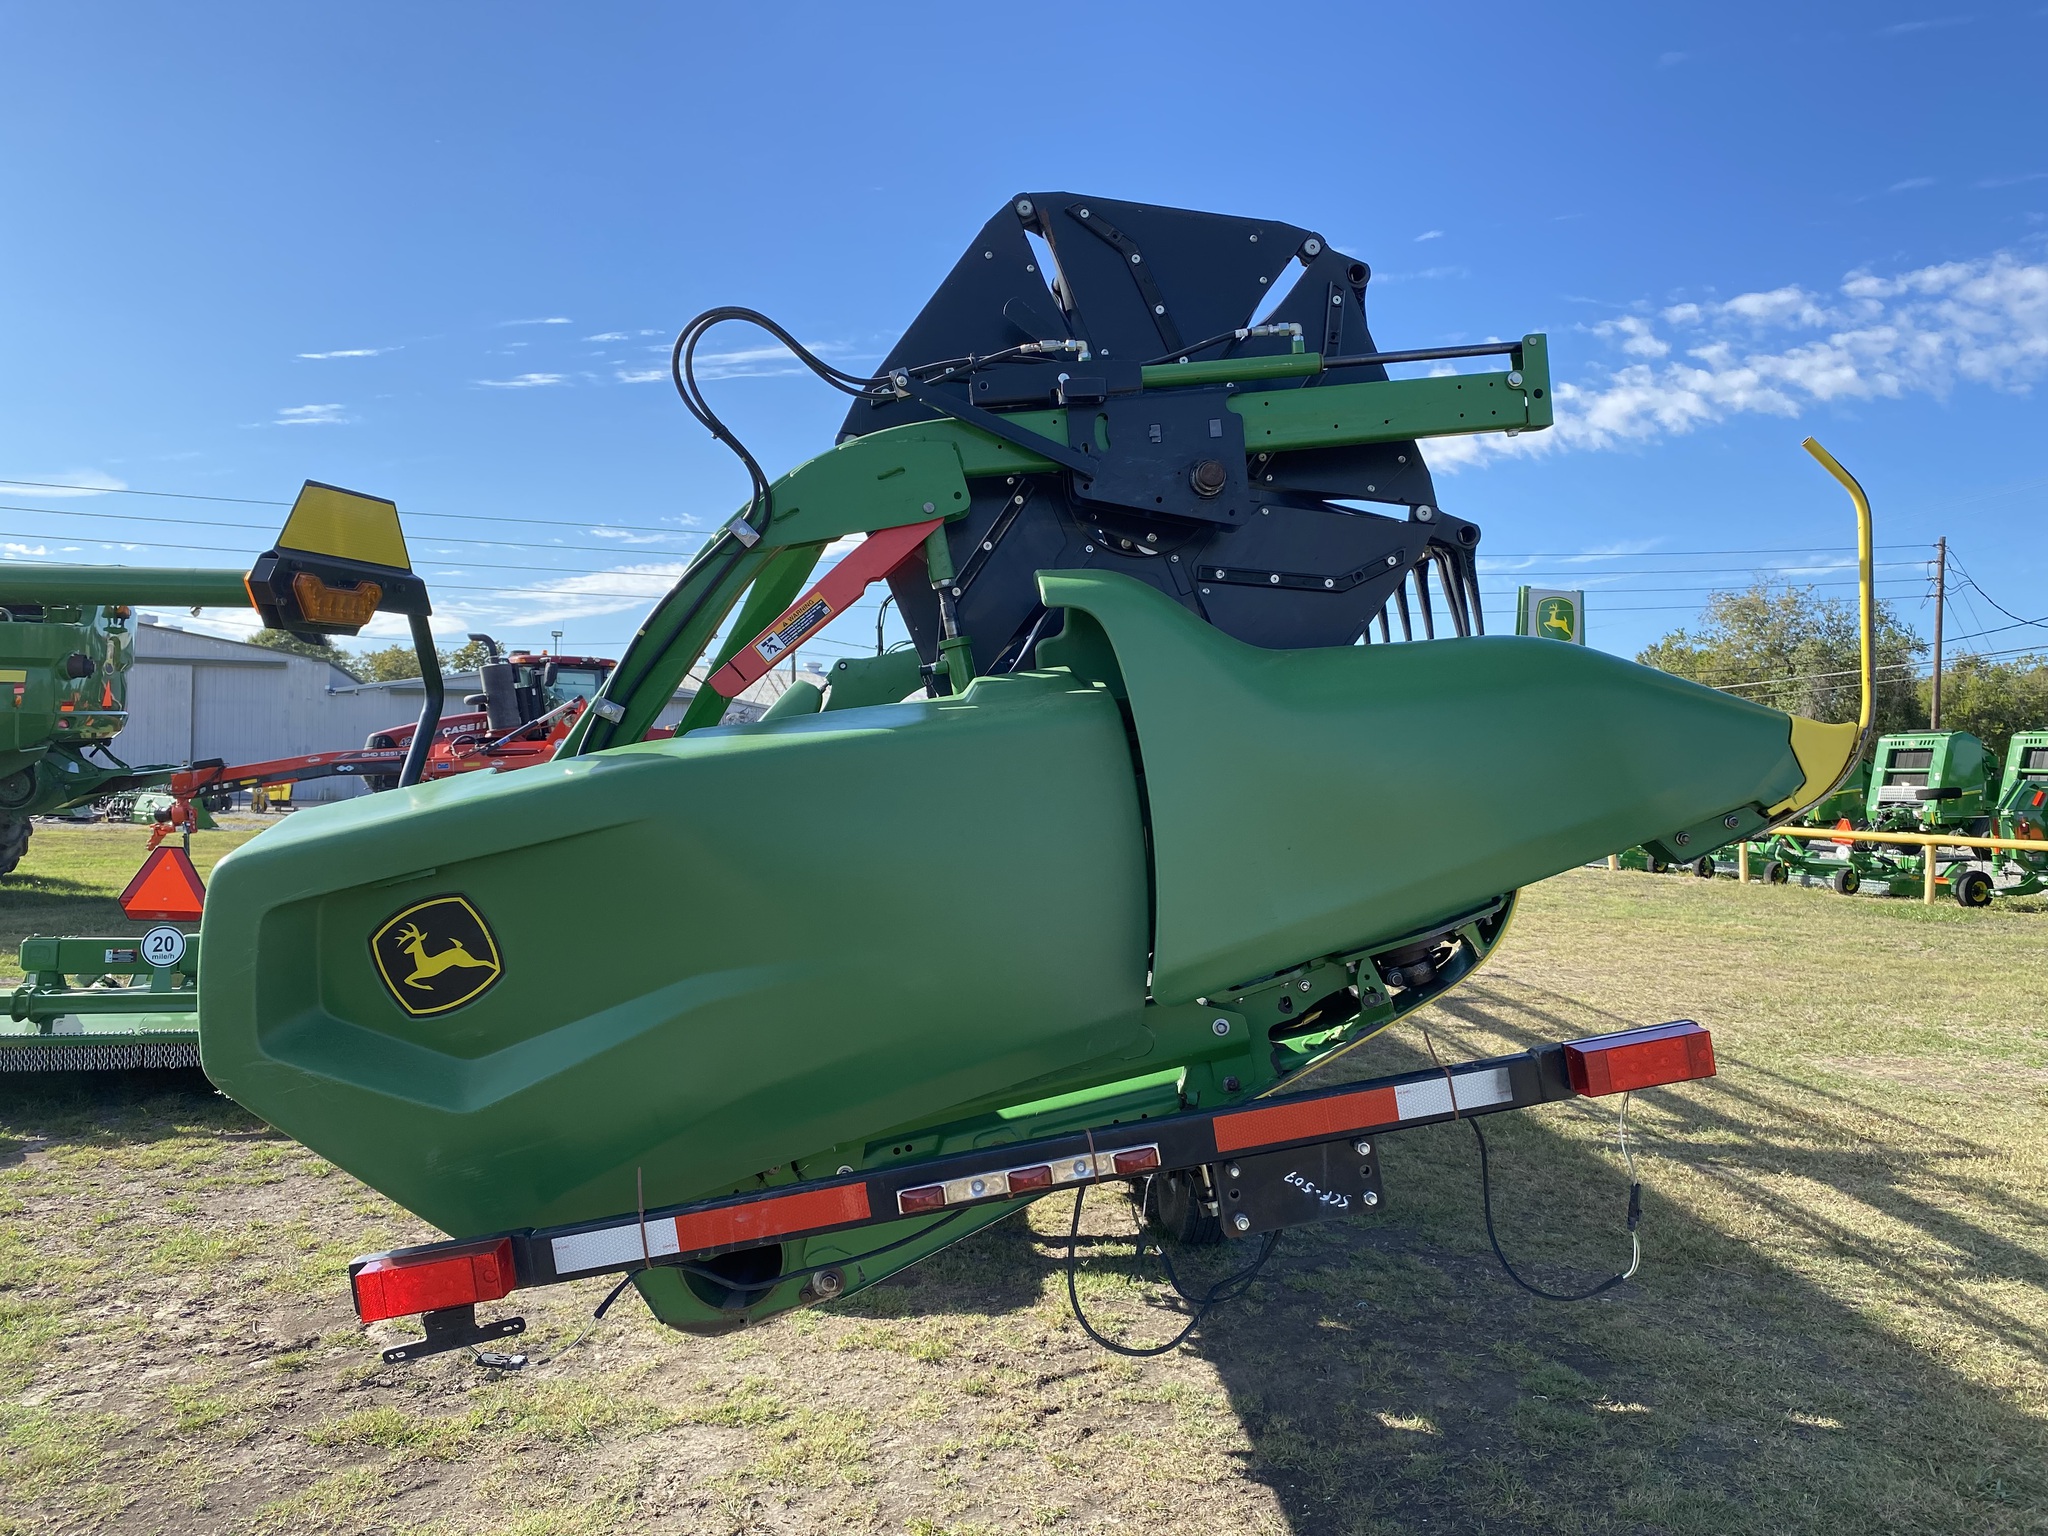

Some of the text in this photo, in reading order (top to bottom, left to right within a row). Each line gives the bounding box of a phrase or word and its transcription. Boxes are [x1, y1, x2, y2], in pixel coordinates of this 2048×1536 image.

[787, 600, 815, 622] WARNING
[442, 723, 475, 735] CASE
[152, 936, 175, 953] 20
